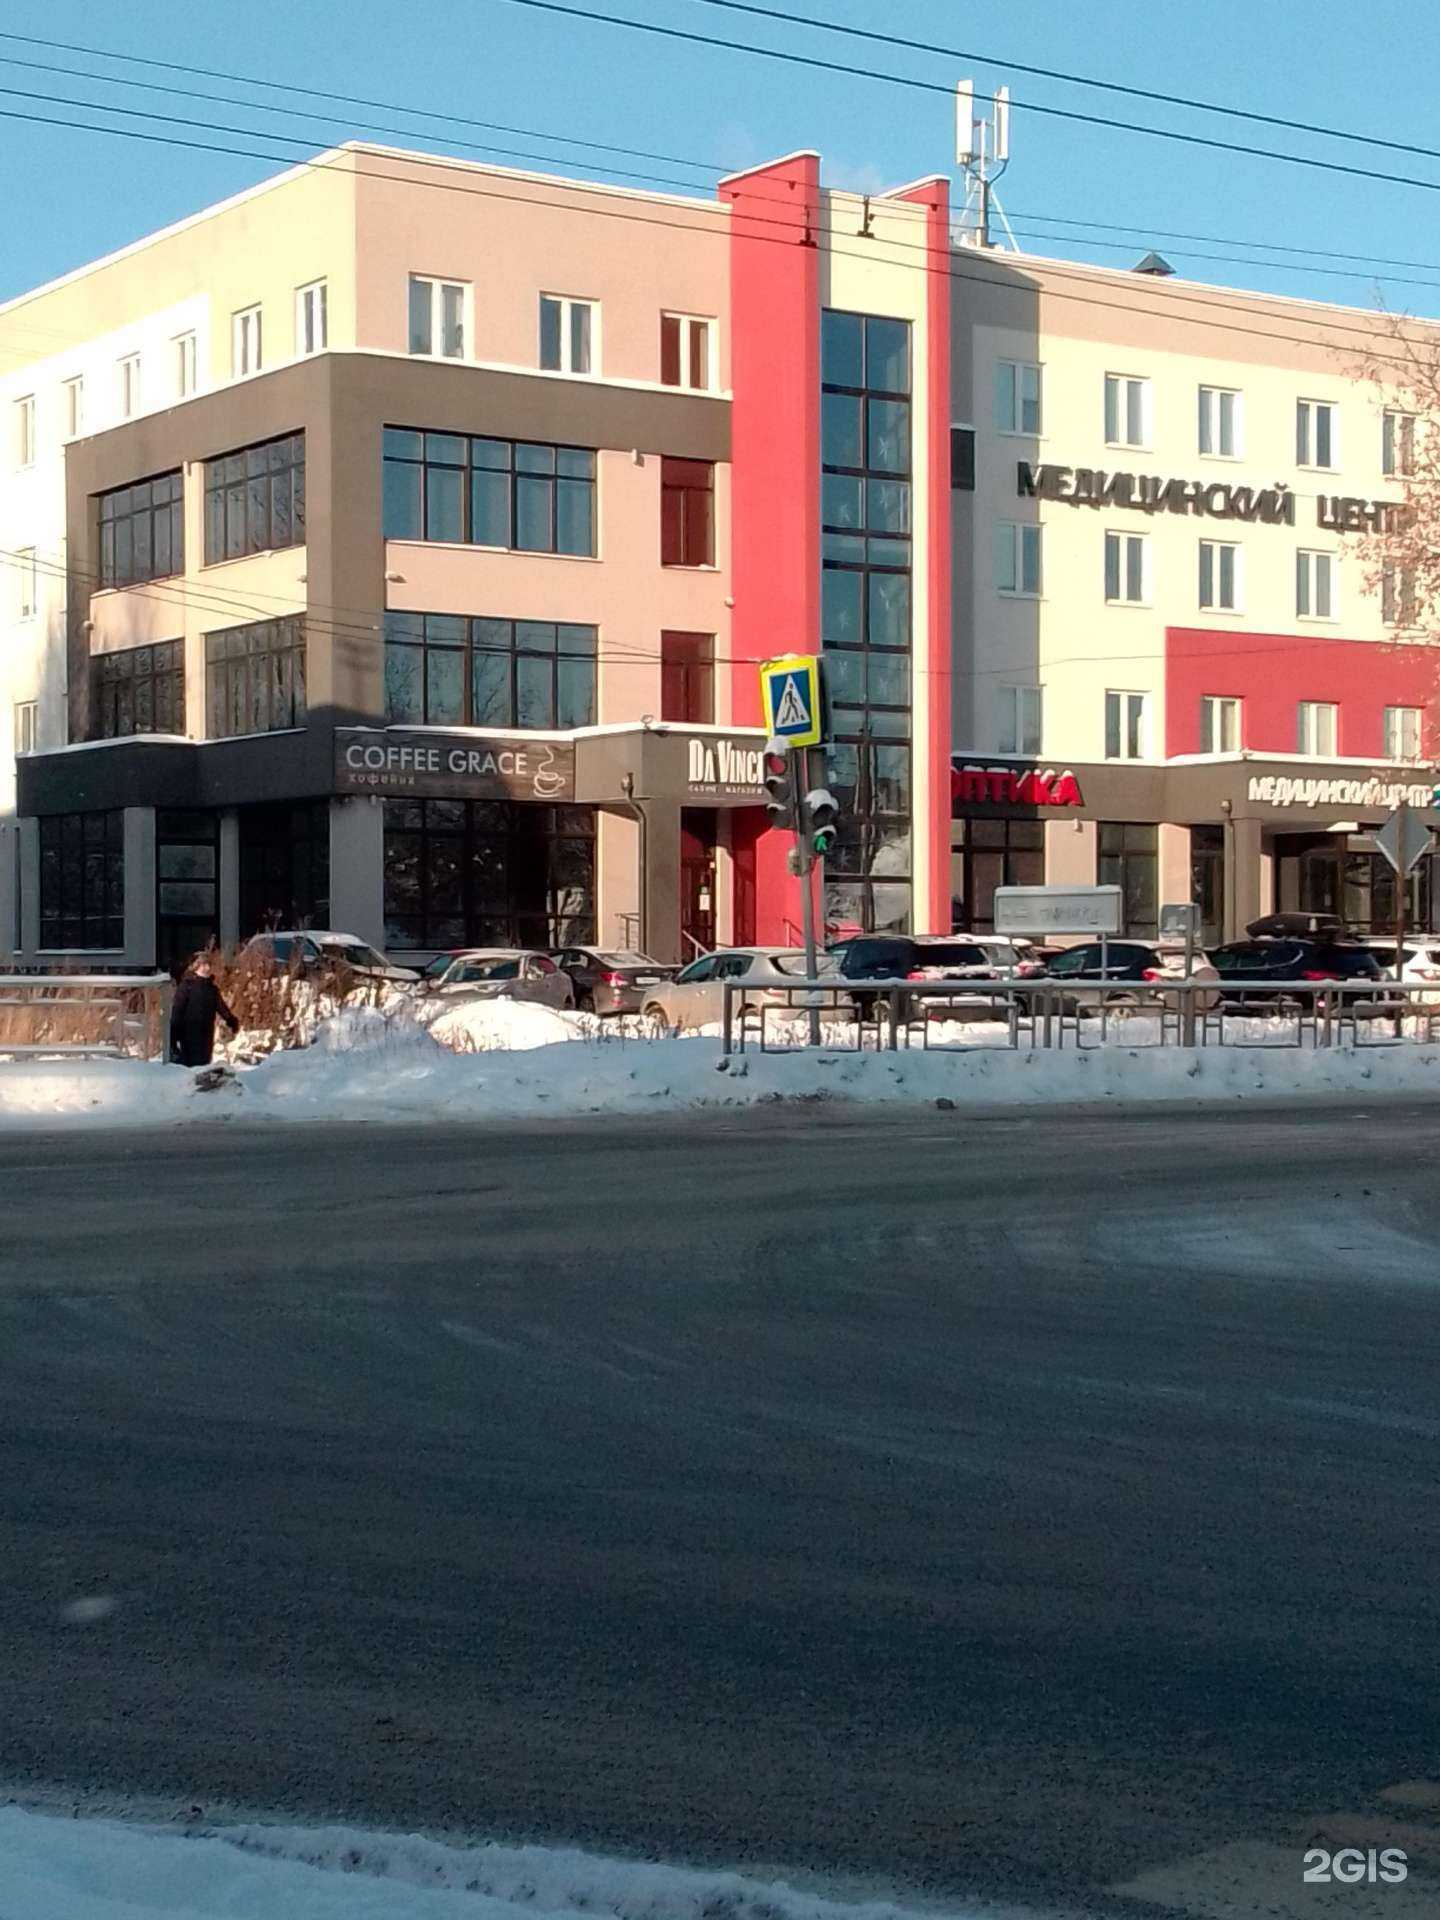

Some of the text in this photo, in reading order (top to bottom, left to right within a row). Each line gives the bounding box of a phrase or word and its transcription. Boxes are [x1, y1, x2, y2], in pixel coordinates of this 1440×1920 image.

[1017, 461, 1295, 526] МЕДИЦИНСКИЙ
[346, 745, 528, 775] COFFEE GRACE
